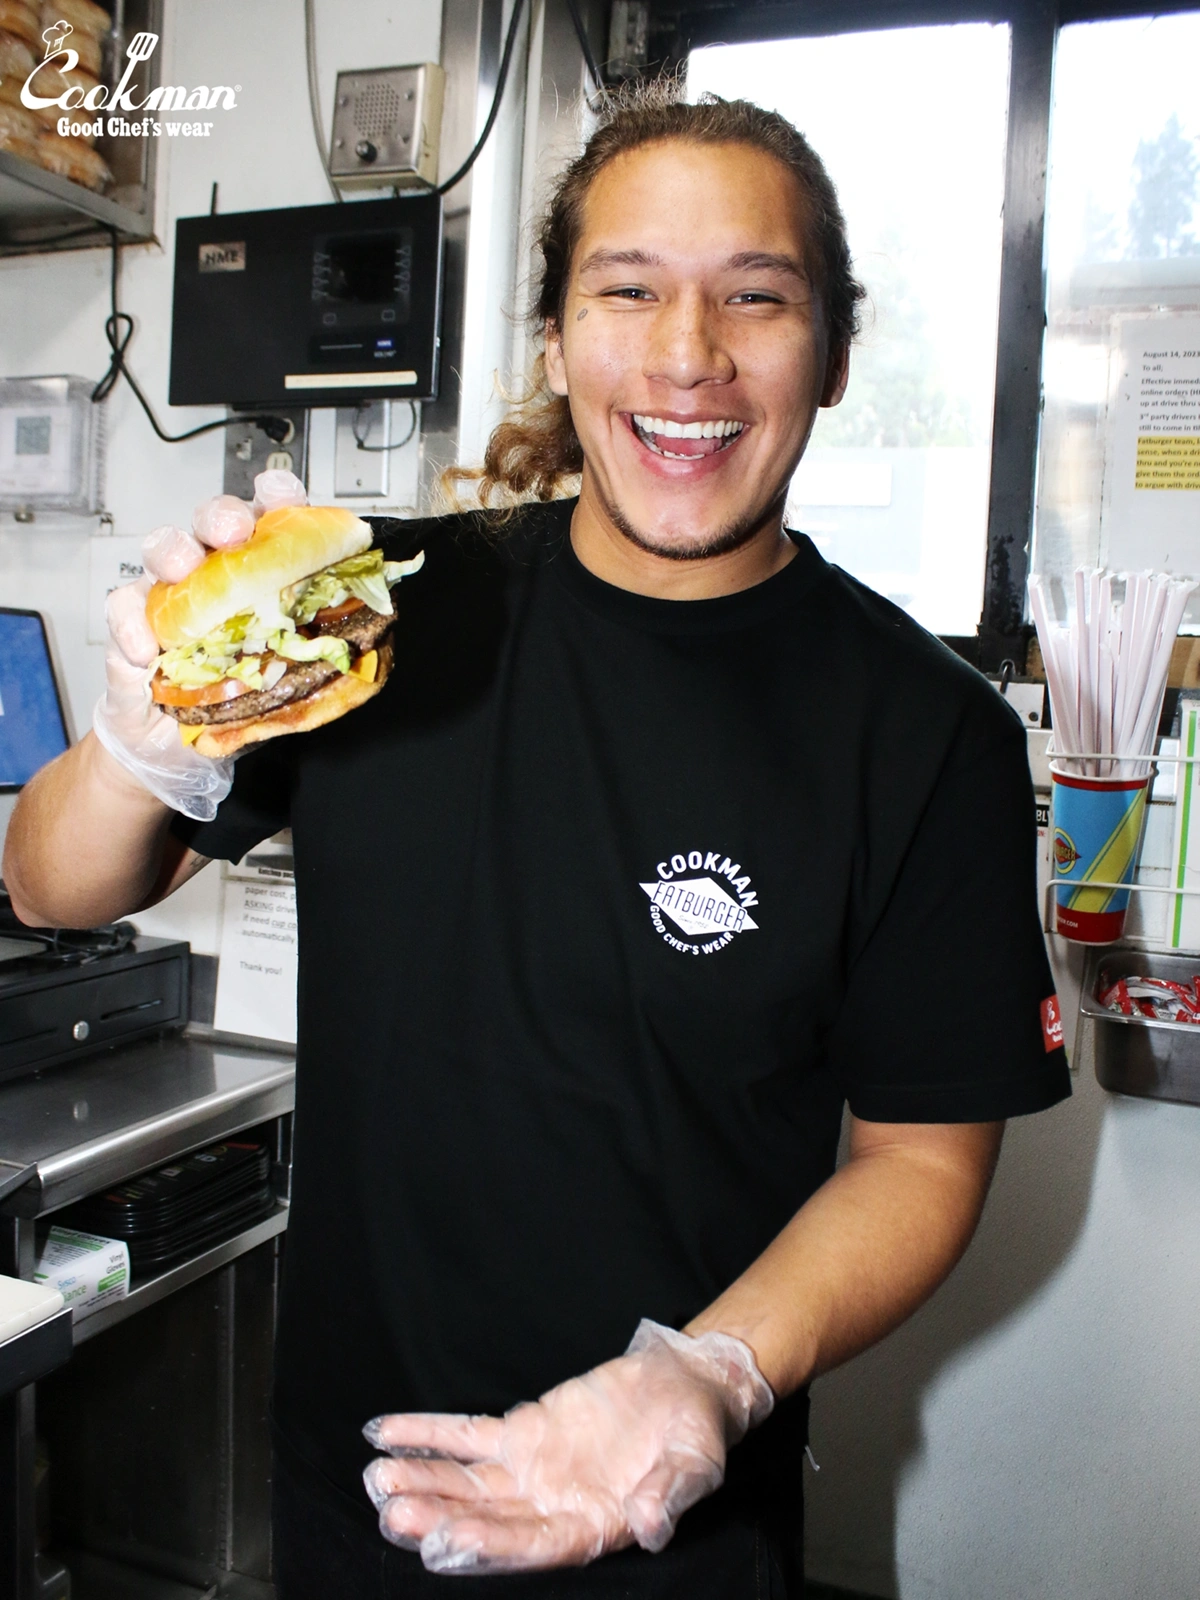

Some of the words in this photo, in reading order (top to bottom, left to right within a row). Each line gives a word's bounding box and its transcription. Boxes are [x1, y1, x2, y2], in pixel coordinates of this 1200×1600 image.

[1143, 351, 1168, 359] August
[1170, 351, 1181, 359] 14,
[1171, 412, 1196, 420] drivers
[1138, 438, 1172, 446] Fatburger
[1174, 438, 1195, 446] team,
[1169, 459, 1192, 468] you're
[1136, 470, 1150, 479] give
[1145, 482, 1165, 490] argue
[657, 851, 759, 908] COOKMAN
[245, 886, 268, 896] paper
[269, 890, 288, 900] cost,
[244, 899, 274, 911] ASKING
[653, 882, 746, 931] FATBURGER
[243, 913, 249, 921] if
[250, 915, 270, 925] need
[271, 919, 286, 929] cup
[242, 929, 295, 944] automatically
[650, 905, 666, 933] GOOD
[663, 933, 699, 955] CHEF'S
[701, 931, 734, 954] WEAR
[240, 960, 263, 972] Thank
[264, 966, 282, 976] you!
[109, 1251, 124, 1263] Vinyl
[106, 1262, 126, 1275] Gloves
[57, 1276, 77, 1290] Sysco
